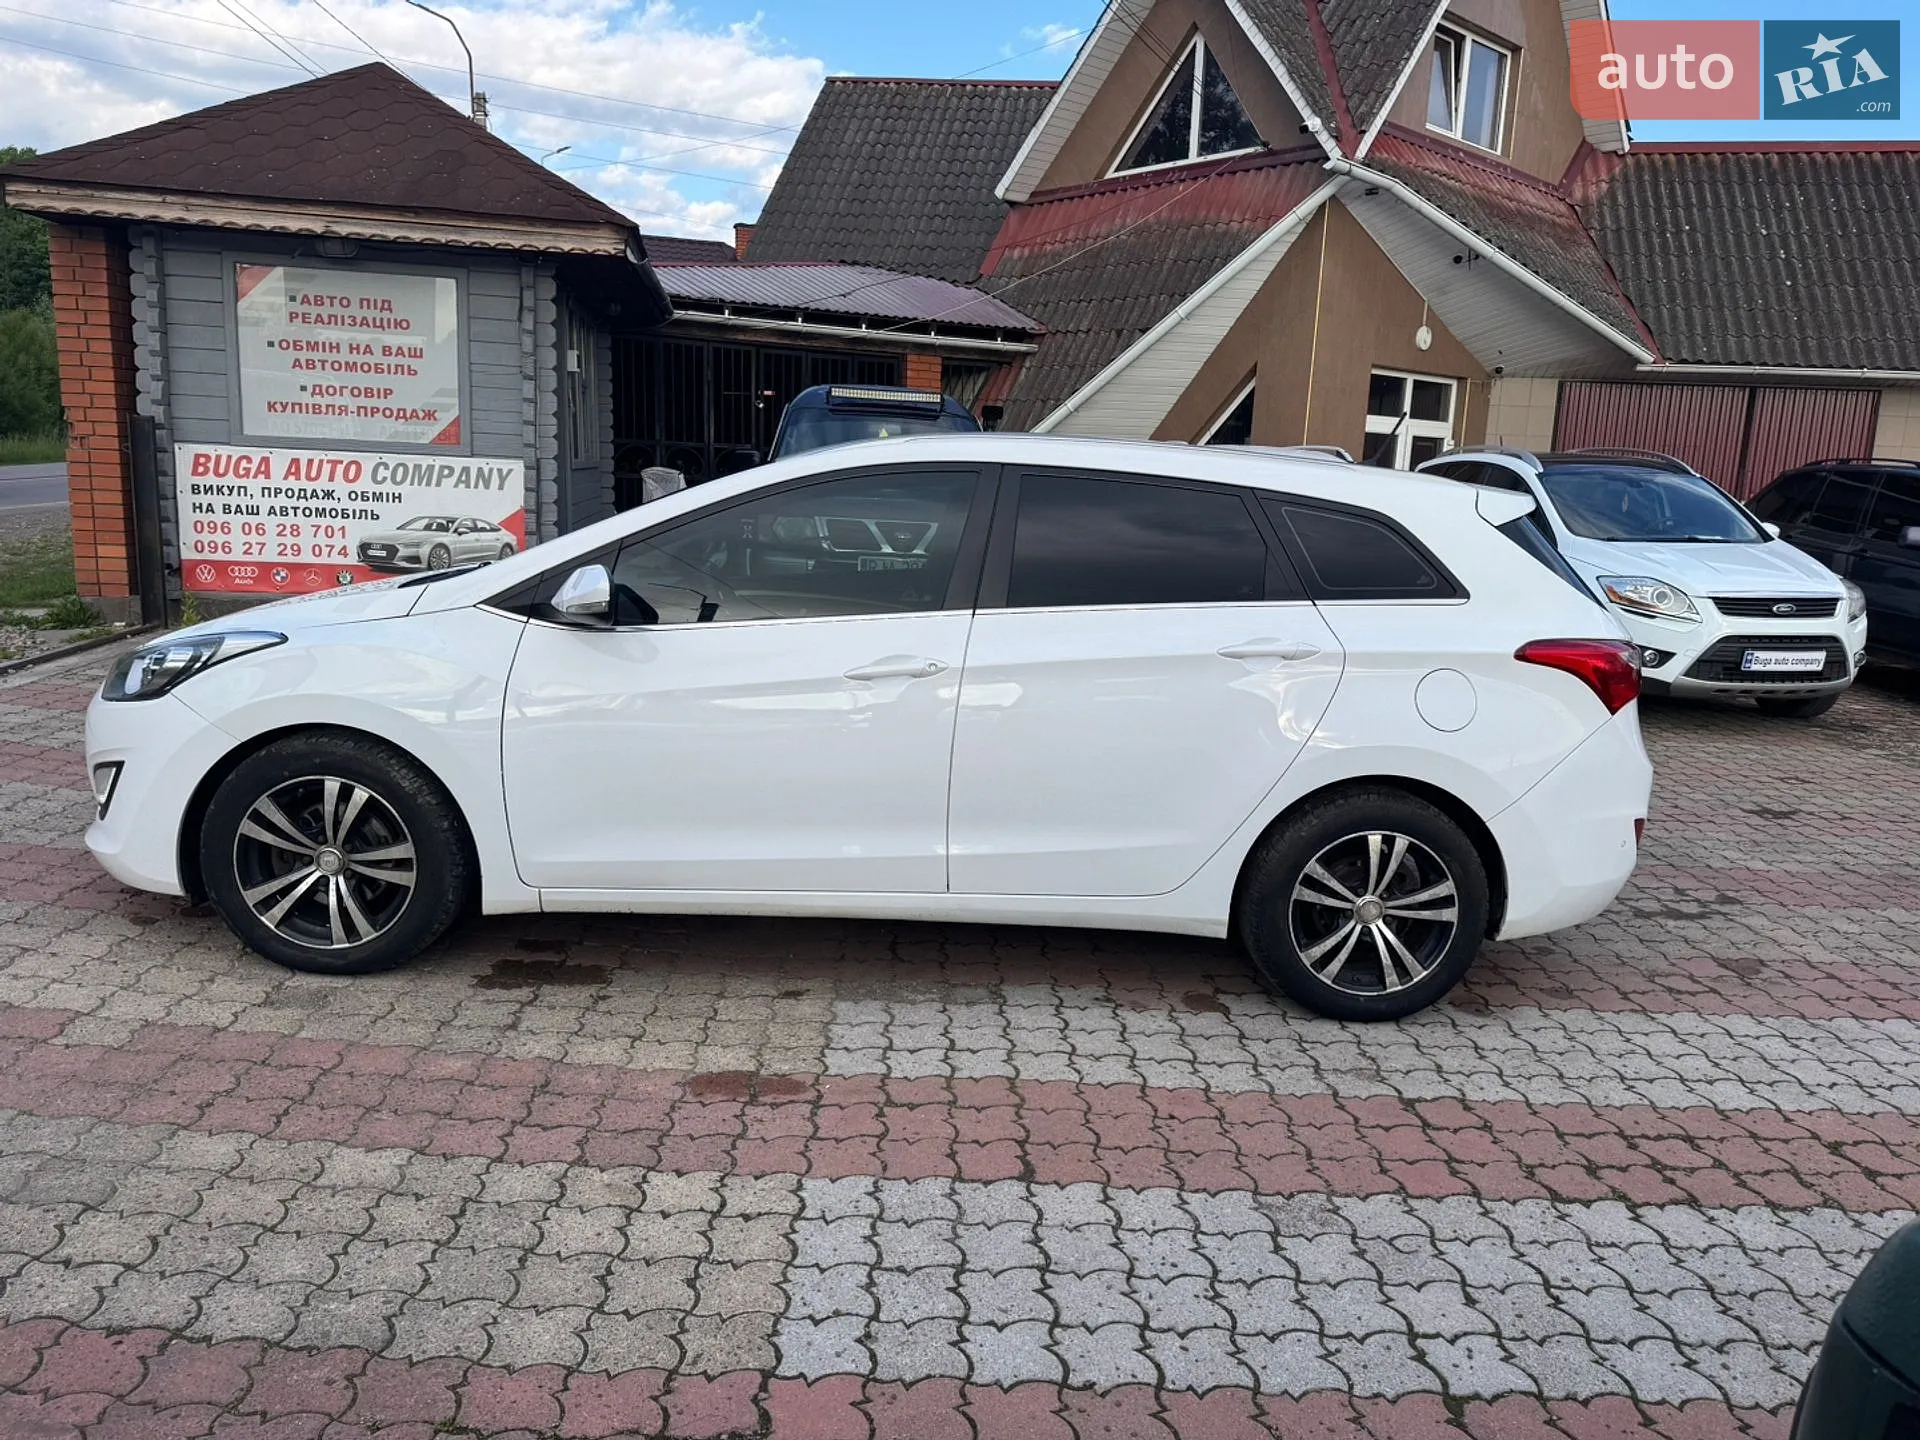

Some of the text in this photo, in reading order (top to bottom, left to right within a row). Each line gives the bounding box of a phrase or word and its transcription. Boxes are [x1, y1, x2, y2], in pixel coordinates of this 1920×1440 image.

[300, 294, 393, 313] АВТО ПІД
[289, 311, 411, 331] РЕАЛІЗАЦІЮ
[278, 339, 424, 359] ОБМІН НА ВАШ
[291, 358, 418, 376] АВТОМОБІЛЬ
[311, 384, 394, 400] ДОГОВІР
[267, 400, 438, 421] КУПІВЛЯ-ПРОДАЖ
[191, 453, 514, 491] BUGA AUTO COMPANY
[191, 484, 402, 503] ВИКУП, ПРОДАЖ, ОБМІН
[192, 502, 380, 520] НА ВАШ АВТОМОБІЛЬ
[193, 520, 347, 539] 096 06 28 701
[194, 539, 349, 558] 096 27 29 074
[234, 577, 254, 585] Audi
[1753, 656, 1821, 668] Buga auto company
